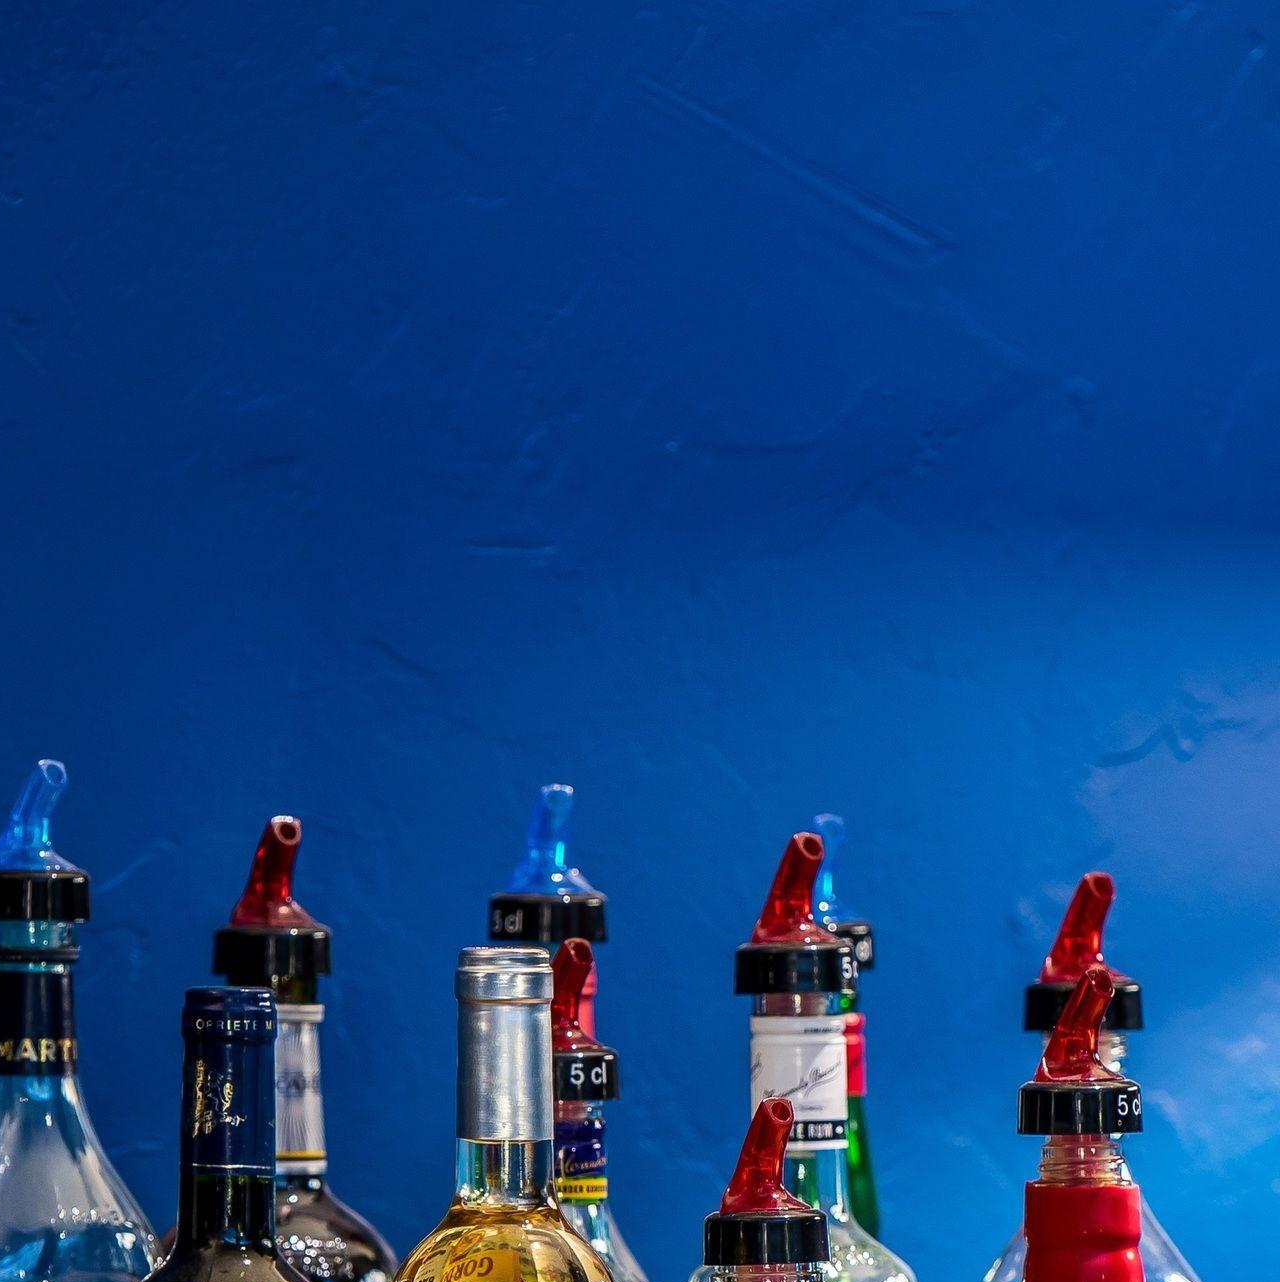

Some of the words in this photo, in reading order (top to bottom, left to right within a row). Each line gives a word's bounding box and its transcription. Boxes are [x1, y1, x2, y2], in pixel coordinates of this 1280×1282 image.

[196, 1018, 257, 1031] OPRIETE
[570, 1063, 585, 1085] 5
[591, 1062, 607, 1084] cl
[1118, 1094, 1129, 1116] 5
